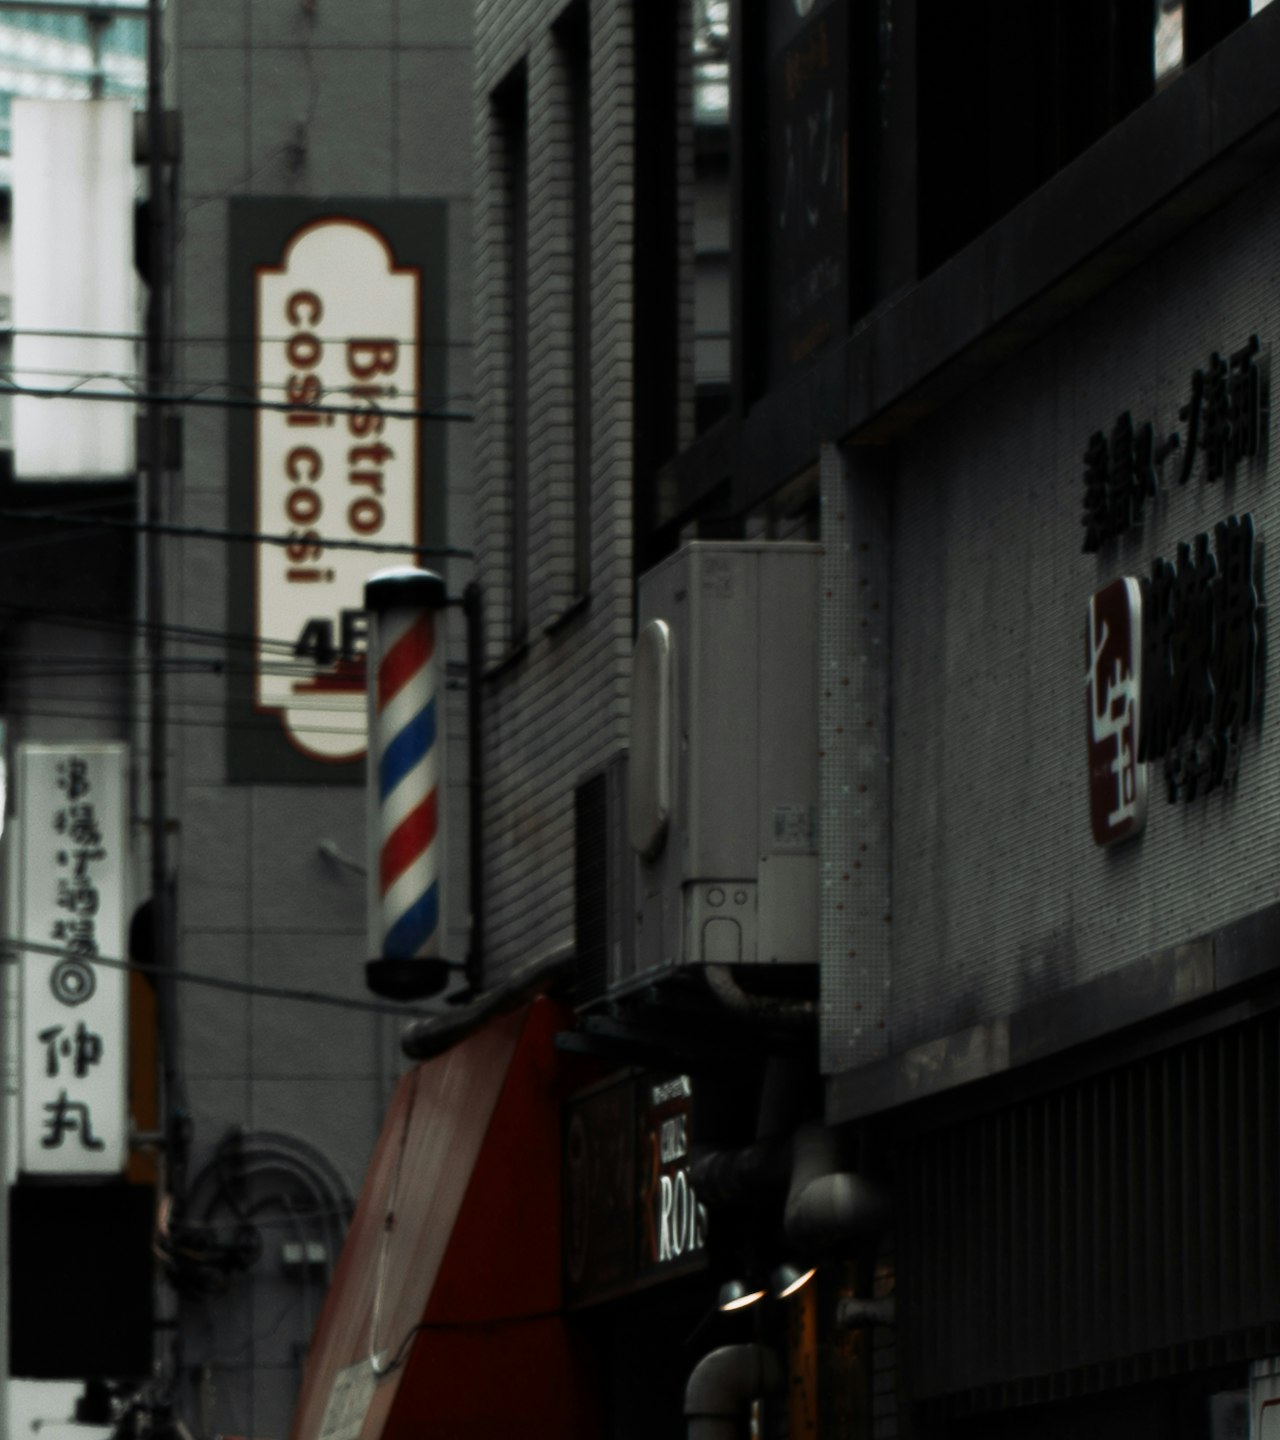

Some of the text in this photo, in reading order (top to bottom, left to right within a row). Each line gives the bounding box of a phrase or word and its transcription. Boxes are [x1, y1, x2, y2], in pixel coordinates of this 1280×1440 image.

[285, 289, 400, 583] Bistro cosi cosi
[37, 1018, 106, 1152] 仲丸
